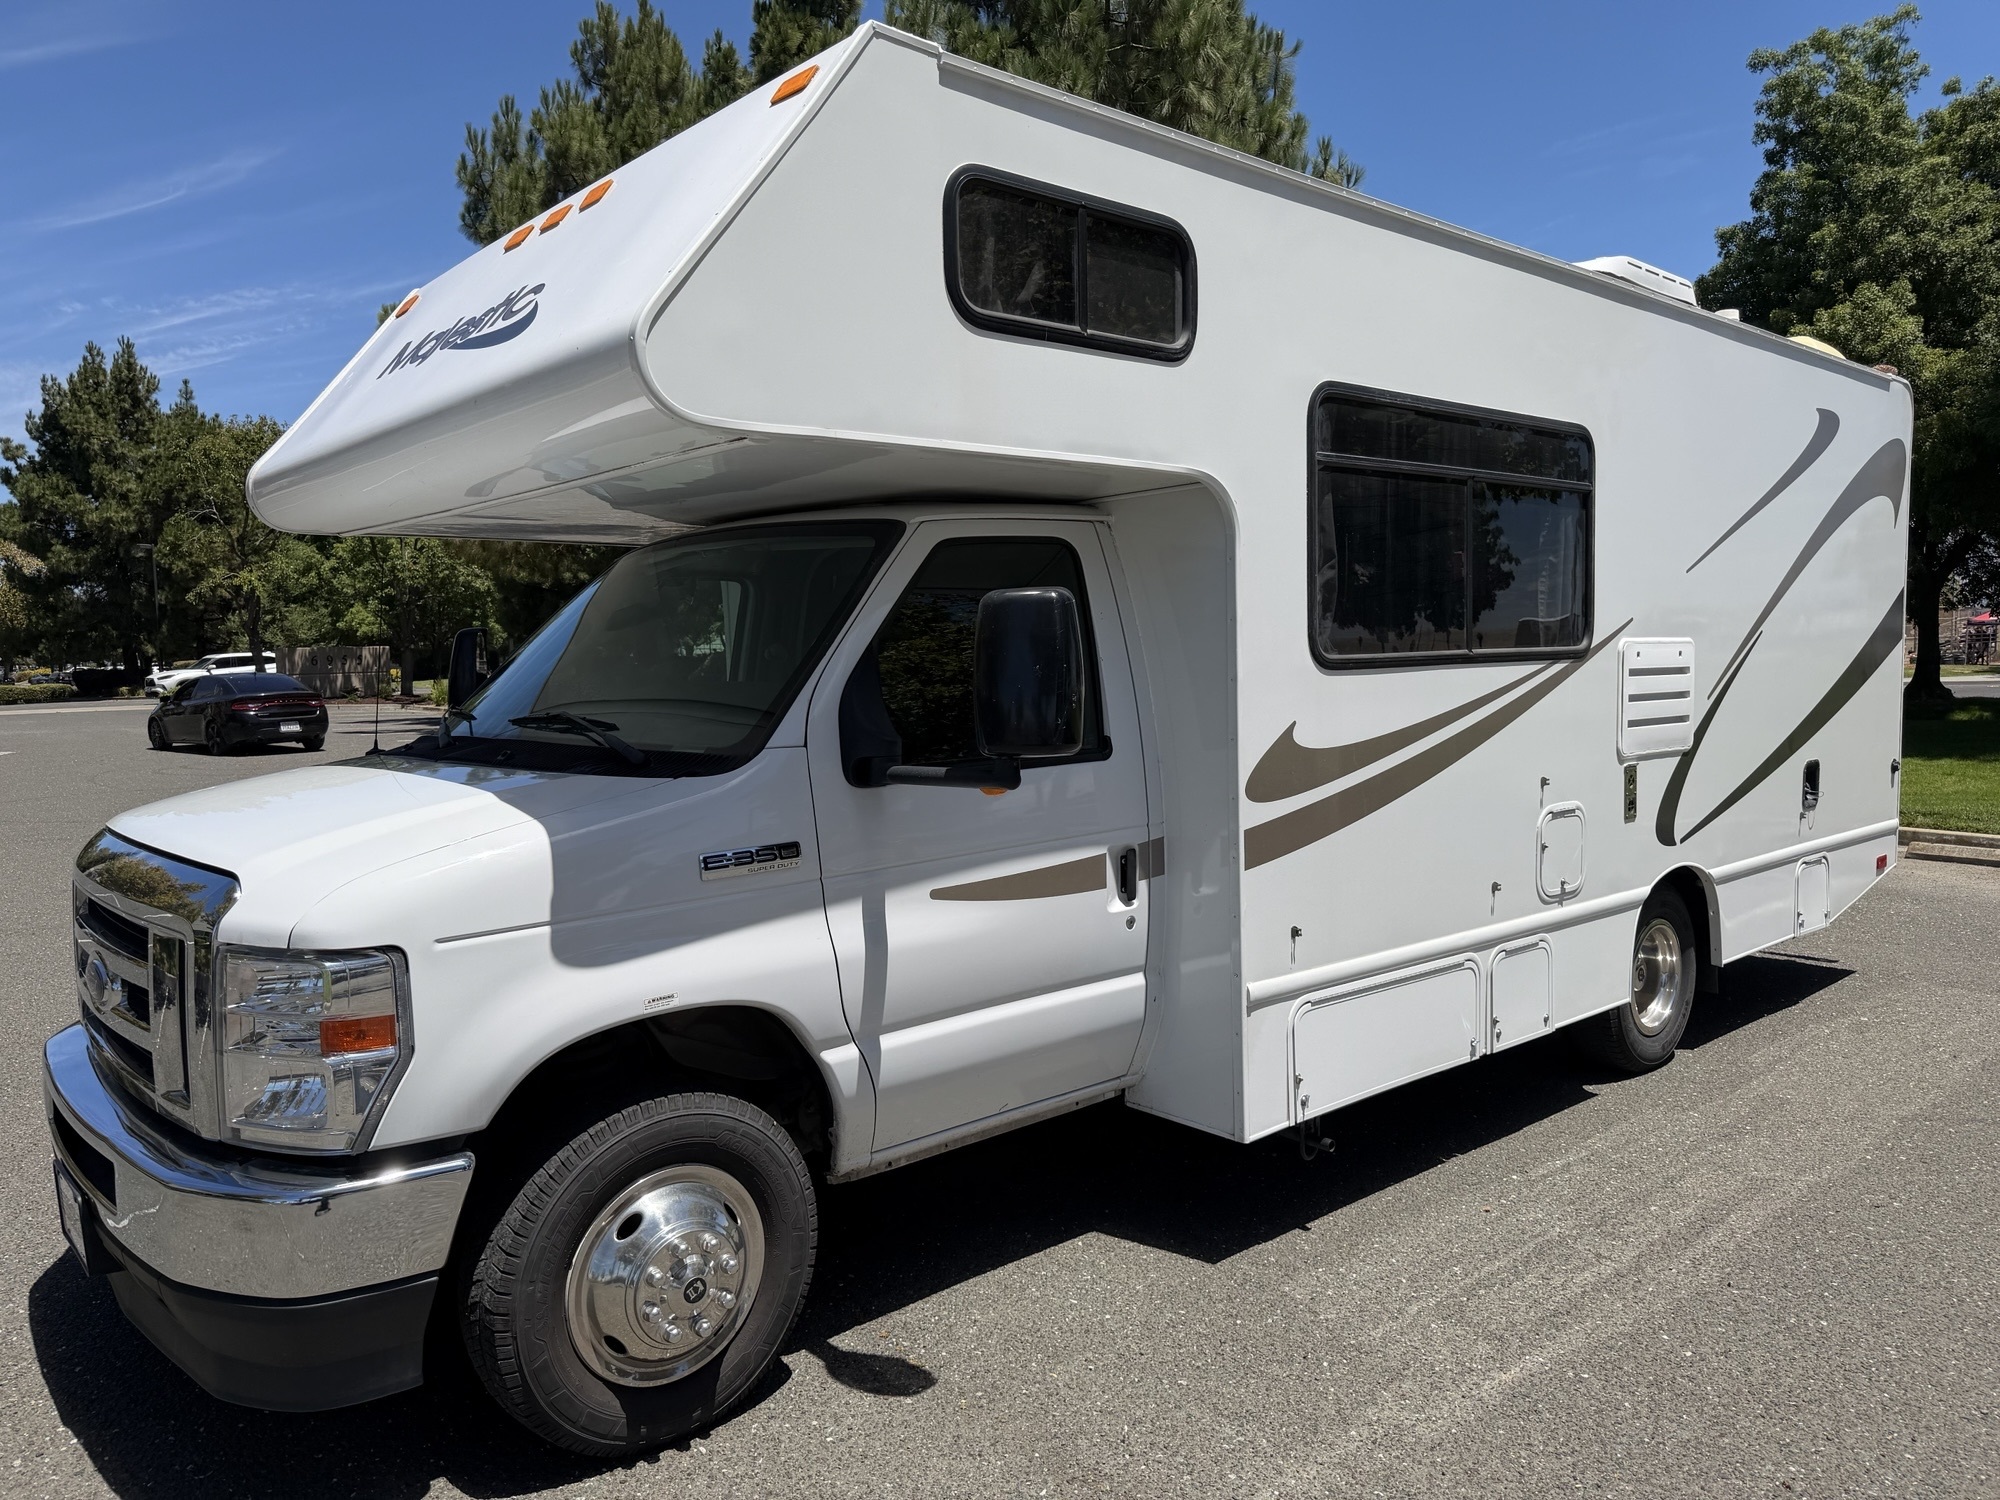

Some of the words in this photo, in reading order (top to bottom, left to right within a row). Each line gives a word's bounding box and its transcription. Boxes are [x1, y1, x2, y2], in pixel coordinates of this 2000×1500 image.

[311, 655, 362, 666] 6955
[702, 841, 801, 871] E-350
[747, 863, 775, 873] SUPER
[777, 860, 800, 869] DUTY
